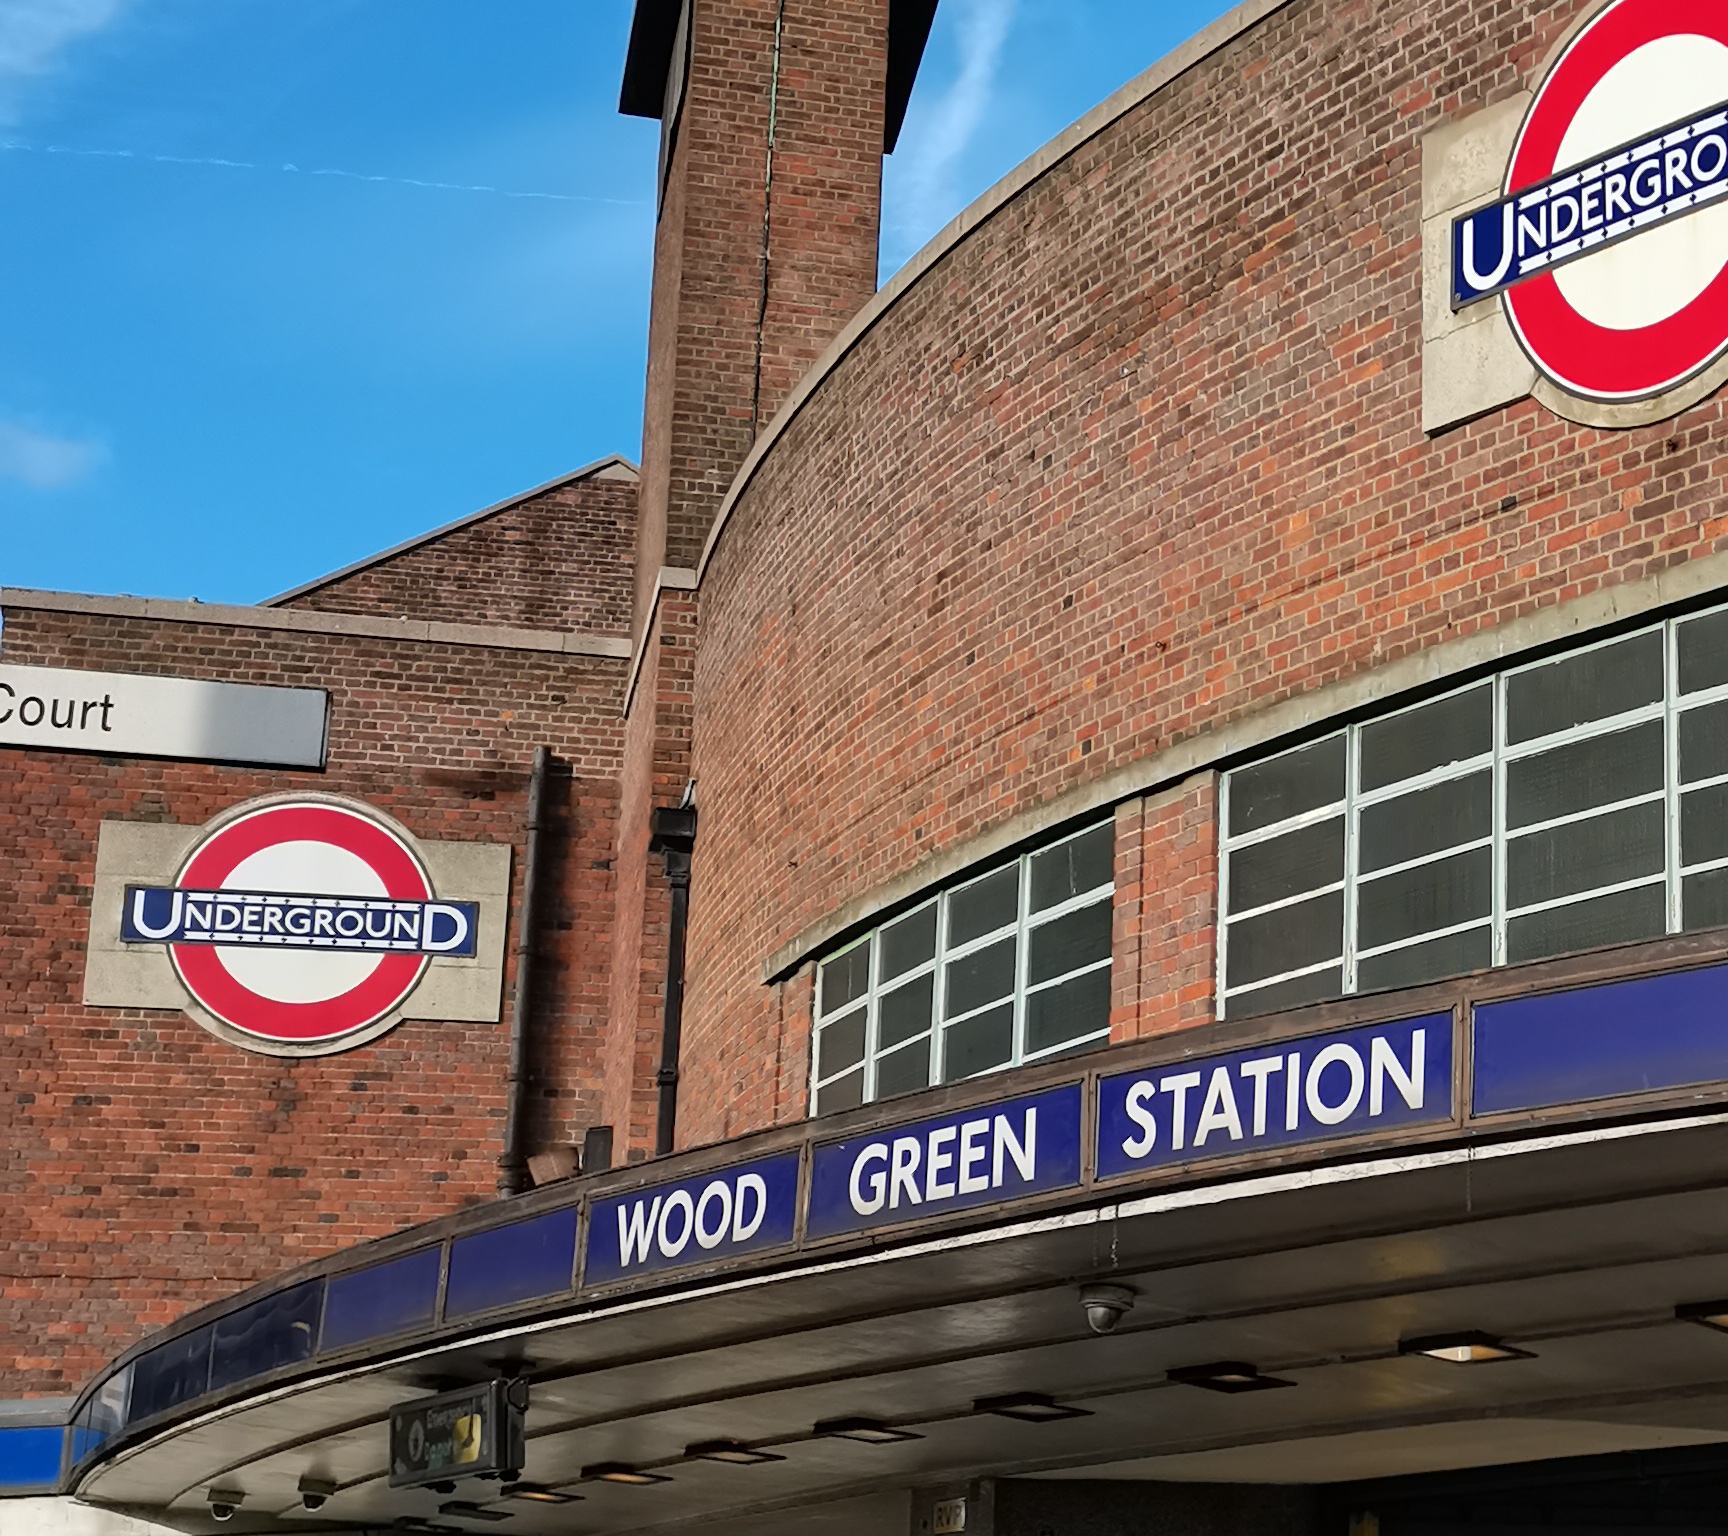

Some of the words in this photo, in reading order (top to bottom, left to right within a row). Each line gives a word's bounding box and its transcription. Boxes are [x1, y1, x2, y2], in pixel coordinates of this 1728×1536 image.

[133, 889, 469, 952] UNDERGROUND
[616, 1172, 768, 1267] WOOD
[848, 1106, 1038, 1216] GREEN
[1122, 1028, 1427, 1160] STATION
